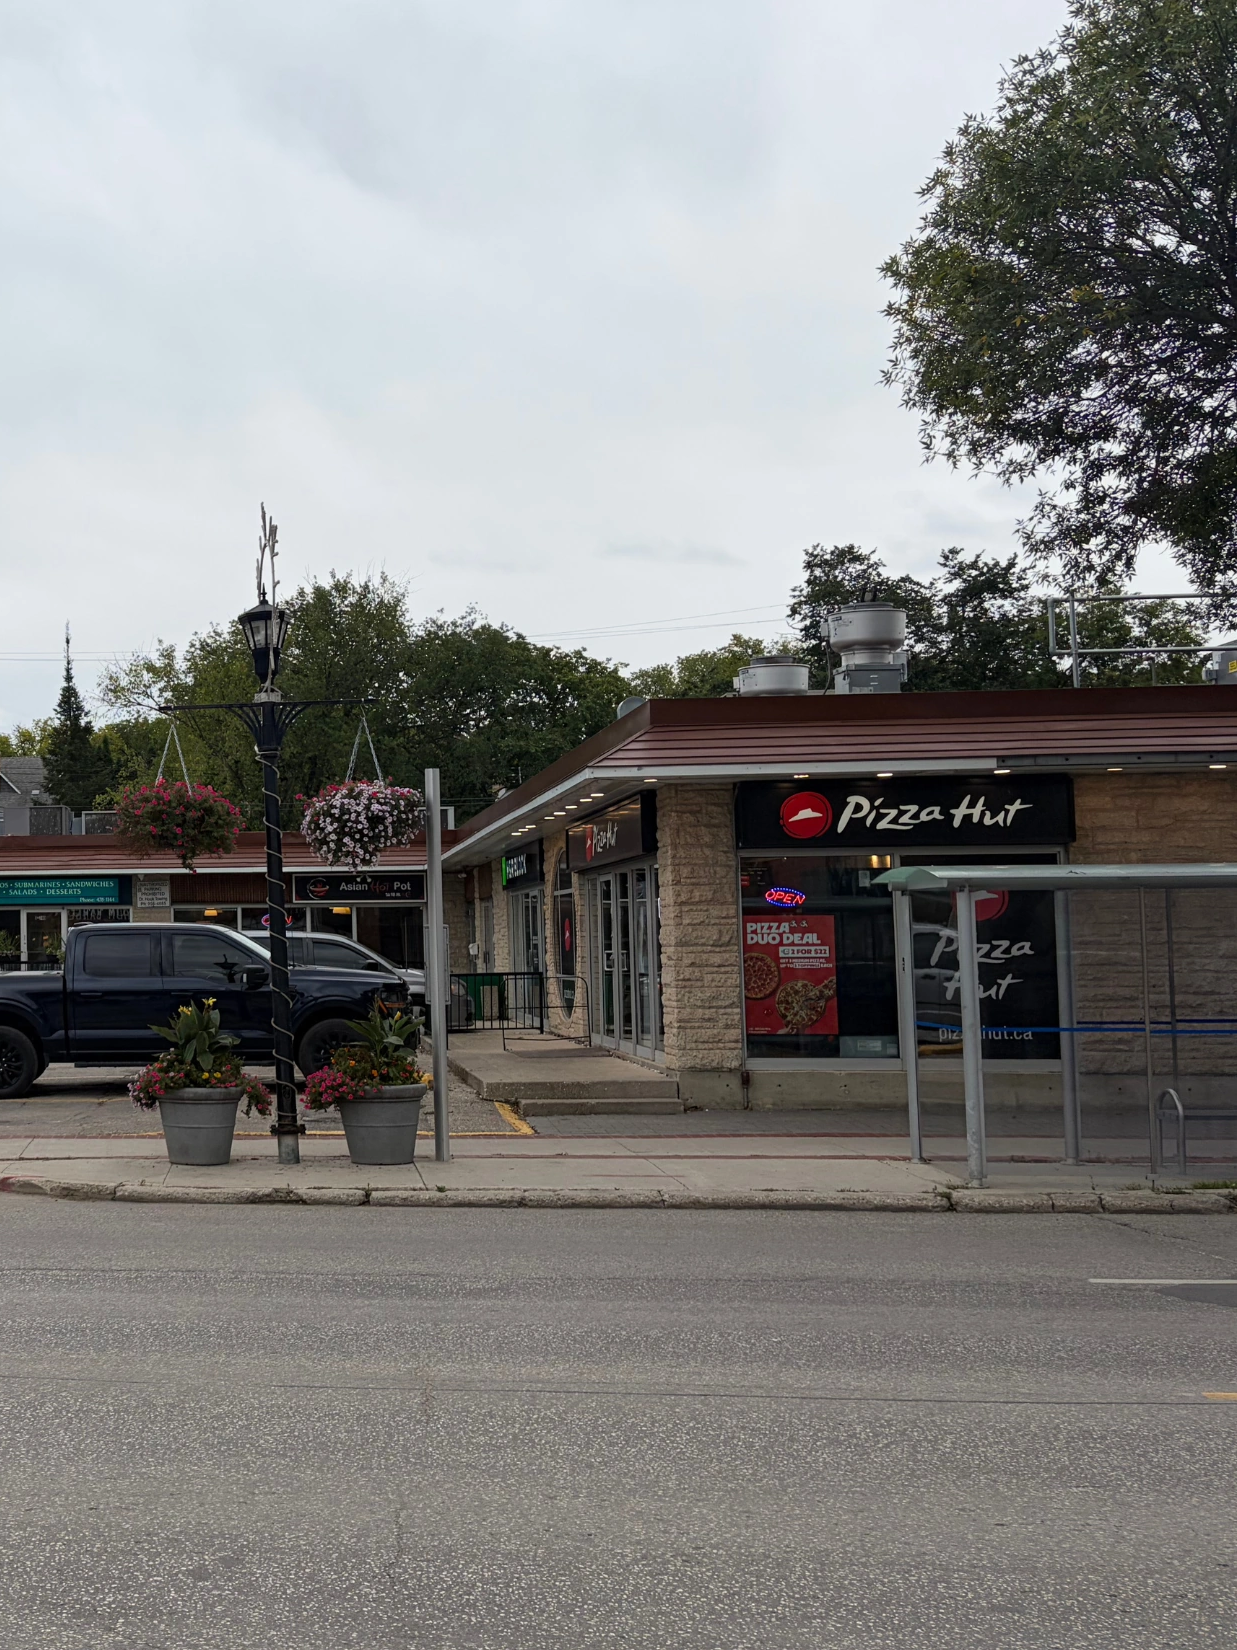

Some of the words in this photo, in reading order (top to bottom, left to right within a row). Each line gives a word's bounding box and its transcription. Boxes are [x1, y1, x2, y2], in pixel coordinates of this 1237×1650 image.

[836, 795, 945, 834] Pizza
[949, 794, 1034, 829] Hut
[339, 881, 368, 891] Asian
[394, 881, 412, 891] Pot
[765, 890, 806, 905] OPEN
[746, 922, 790, 934] PIZZA
[747, 933, 780, 945] DUO
[782, 933, 821, 944] DEAL
[930, 930, 1035, 967] Pzza
